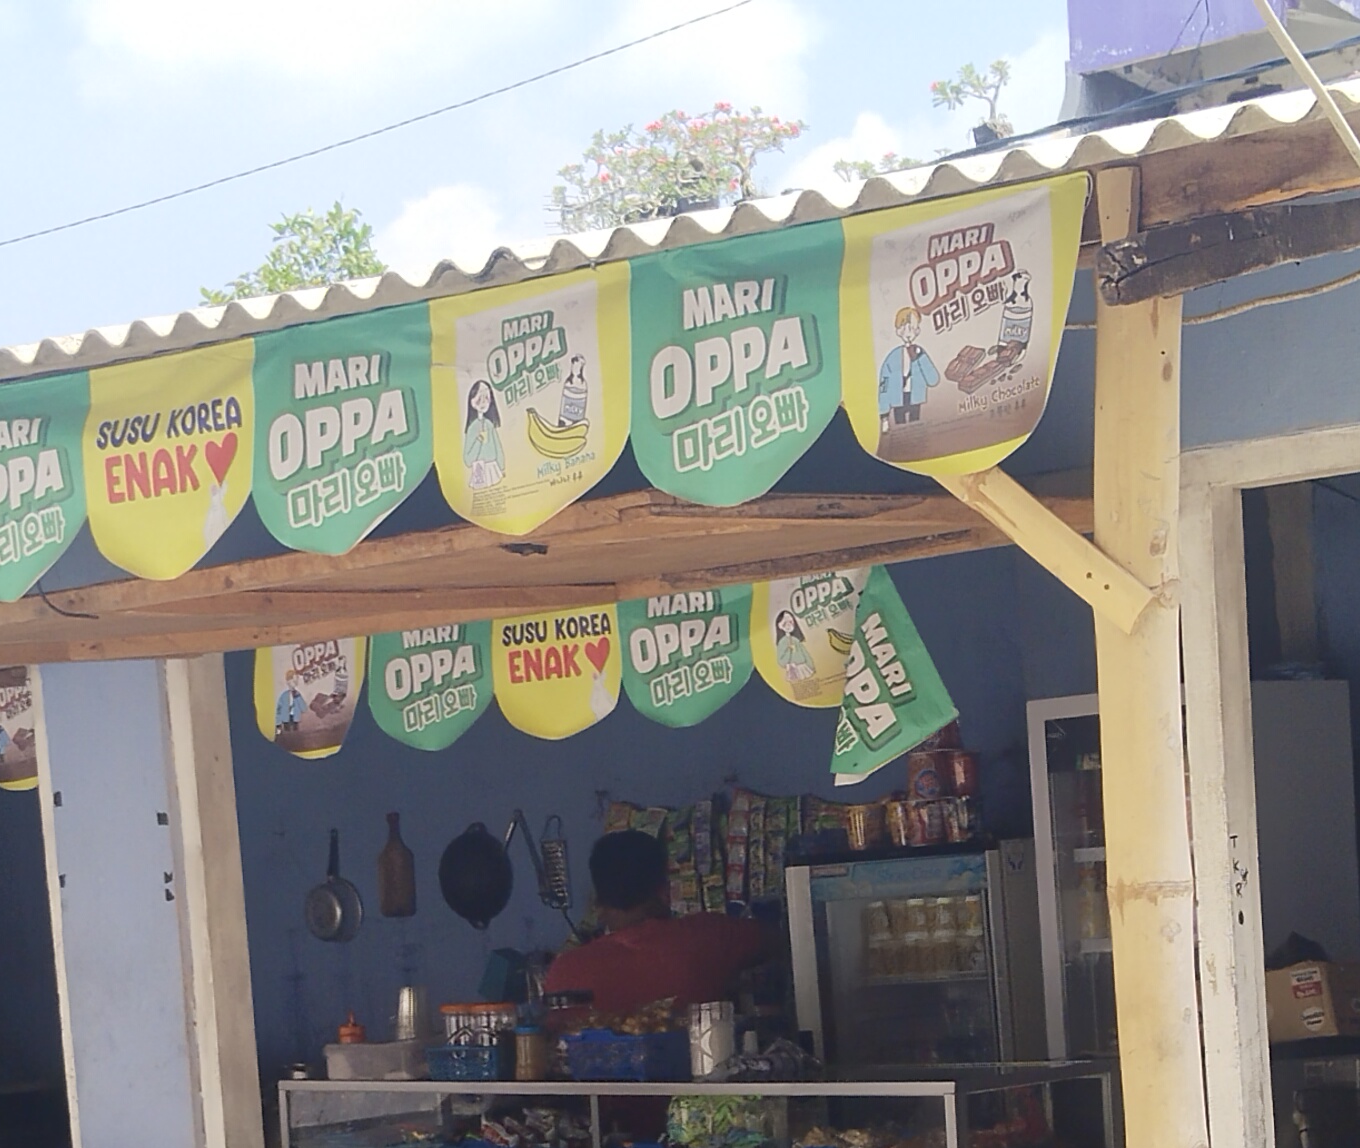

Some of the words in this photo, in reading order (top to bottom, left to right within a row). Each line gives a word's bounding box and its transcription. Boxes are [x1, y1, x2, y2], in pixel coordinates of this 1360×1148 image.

[931, 225, 988, 259] MARI
[911, 243, 1006, 308] OPPA
[504, 313, 549, 342] MARI
[683, 278, 776, 330] MARI
[295, 354, 381, 398] MARI
[489, 329, 560, 385] OPPA
[650, 317, 809, 420] OPPA
[958, 394, 987, 413] Milky
[991, 376, 1040, 401] Chocolate
[97, 414, 160, 451] SUSU
[167, 396, 242, 438] KOREA
[269, 390, 407, 481] OPPA
[673, 409, 746, 474] 마리
[749, 387, 809, 450] 오빠
[105, 442, 200, 504] ENAK
[288, 475, 351, 529] 마리
[353, 450, 407, 506] 오빠
[22, 505, 65, 557] 오빠
[647, 591, 715, 618] MARI
[793, 578, 847, 614] OPPA
[294, 641, 336, 670] OPPA
[403, 625, 459, 649] MARI
[502, 621, 547, 647] SUSU
[555, 613, 611, 640] KOREA
[630, 615, 730, 673] OPPA
[861, 613, 912, 696] MARI
[385, 646, 475, 701] OPPA
[508, 644, 582, 684] ENAK
[650, 665, 692, 707] 마리
